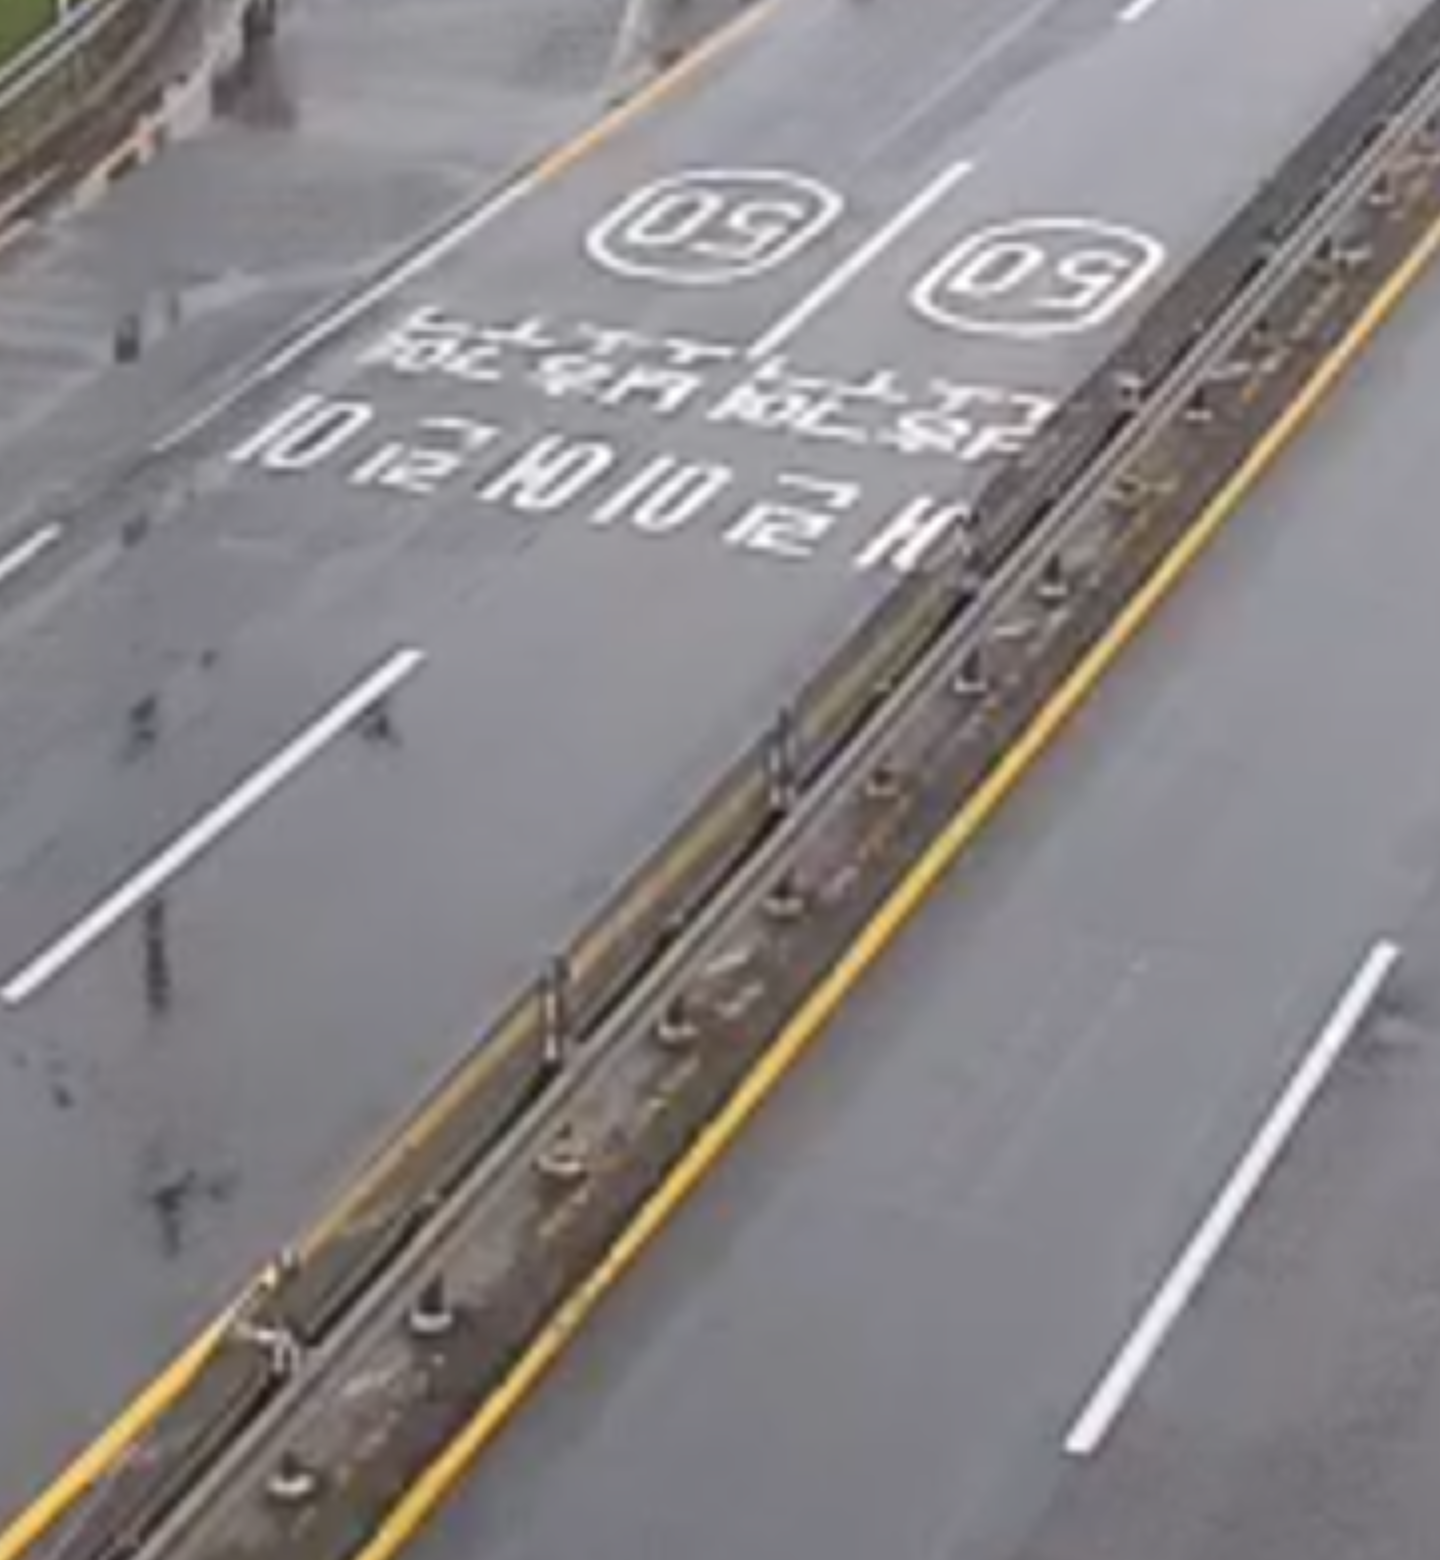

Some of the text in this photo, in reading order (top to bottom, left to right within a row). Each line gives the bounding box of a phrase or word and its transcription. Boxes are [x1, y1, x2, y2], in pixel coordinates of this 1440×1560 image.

[625, 188, 804, 261] 50
[944, 241, 1131, 310] 50
[228, 393, 614, 511] 어린이
